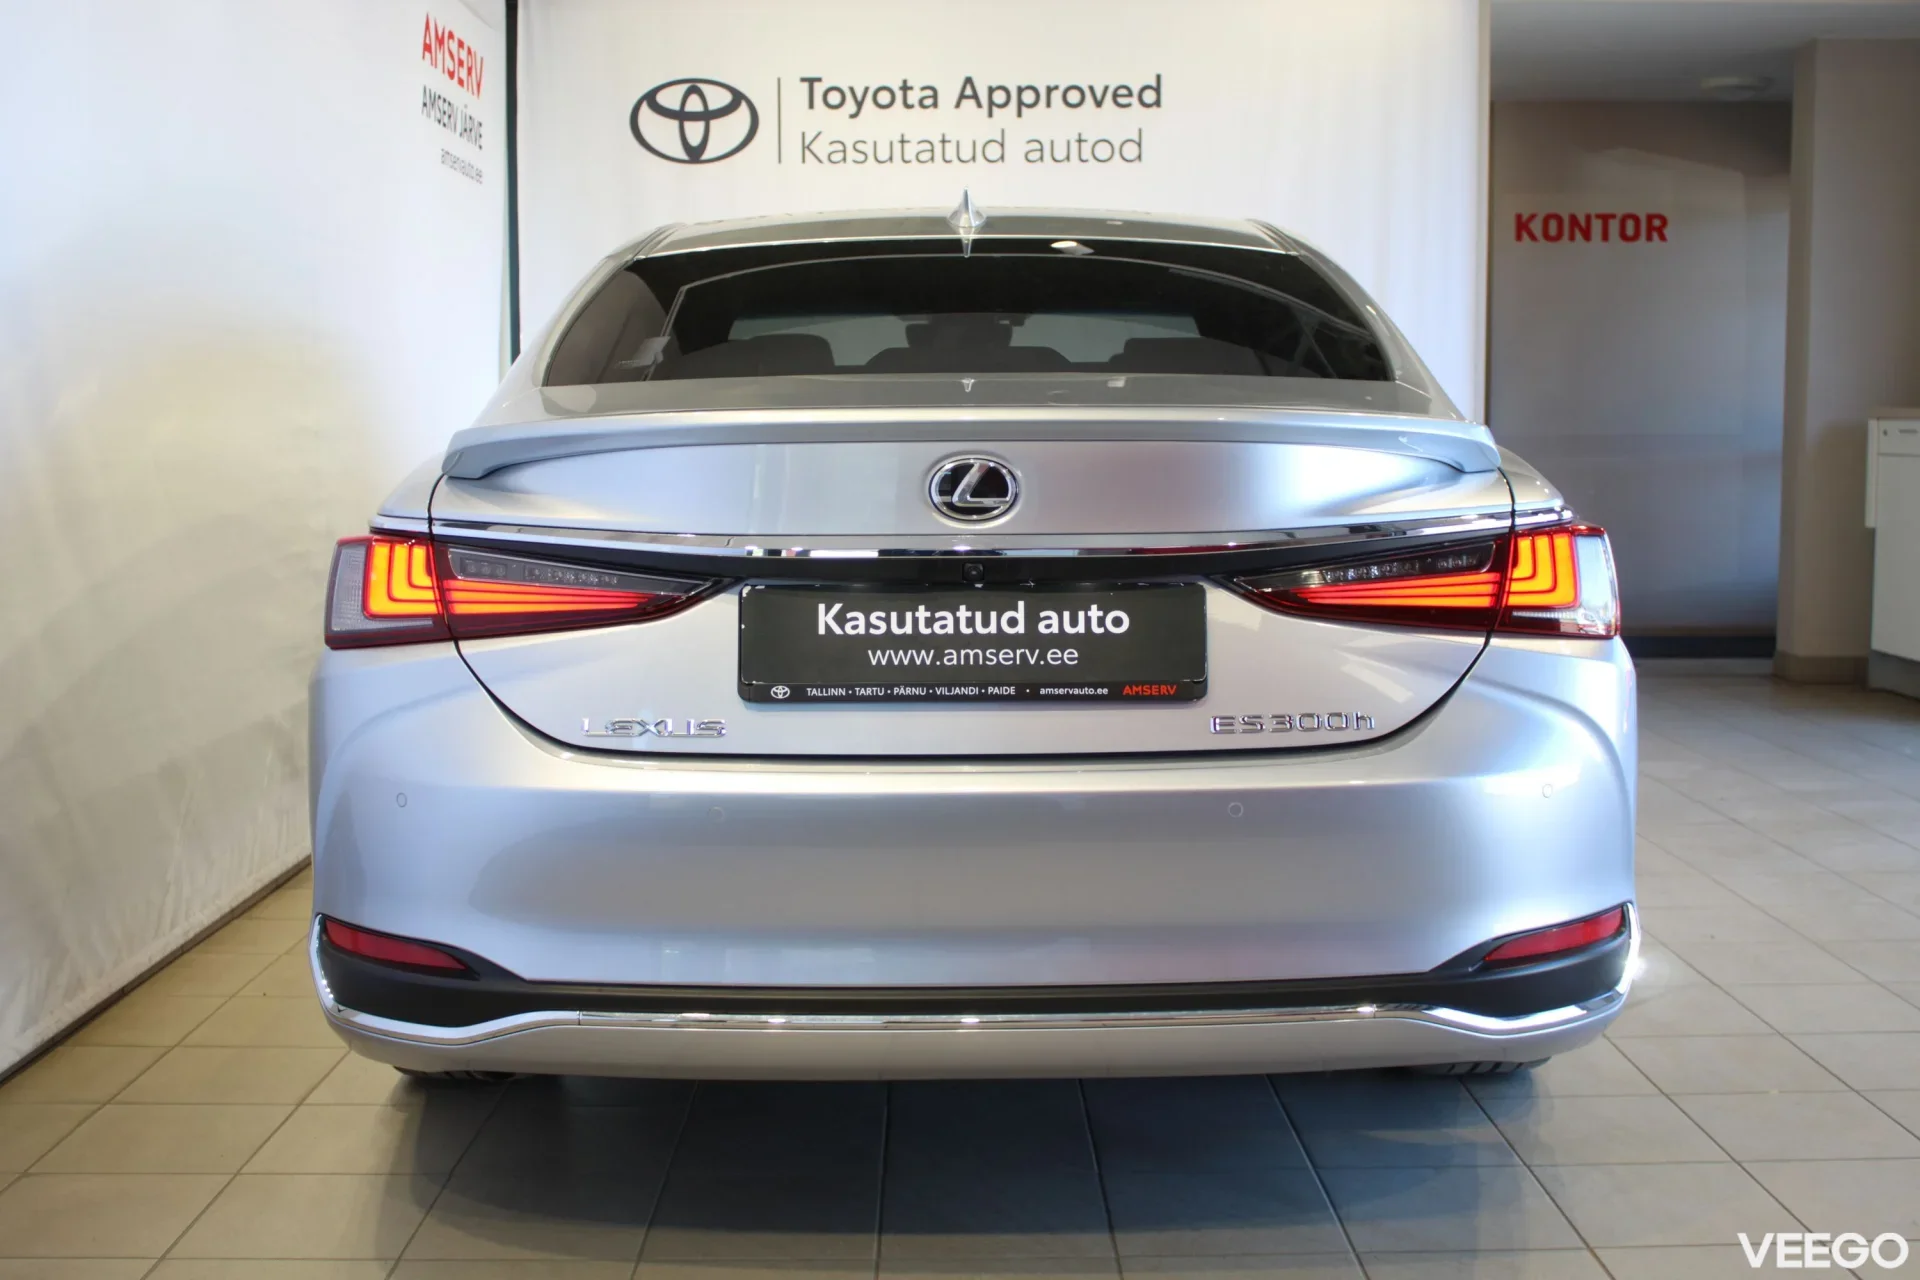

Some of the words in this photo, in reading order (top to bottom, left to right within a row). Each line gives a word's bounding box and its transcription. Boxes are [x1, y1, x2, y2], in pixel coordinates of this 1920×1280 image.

[421, 11, 484, 100] AMSERV
[800, 76, 939, 119] Toyota
[954, 74, 1162, 119] Approved
[421, 84, 459, 135] AMSERV
[459, 104, 483, 150] JÄRVE
[801, 128, 1005, 164] Kasutatud
[1024, 128, 1143, 163] autod
[1514, 212, 1668, 243] KONTOR
[817, 601, 1025, 635] Kasutatud
[1037, 604, 1130, 634] auto
[868, 645, 1079, 666] www.amserv.ee
[806, 687, 846, 697] TALLINN
[854, 687, 885, 696] TARTU
[893, 685, 927, 696] PÄRNU
[935, 686, 979, 696] VILJANDI
[987, 686, 1016, 695] PAIDE
[1039, 686, 1109, 696] amservauto.ee
[1122, 685, 1177, 696] AMSERV
[581, 718, 727, 738] LEXUS
